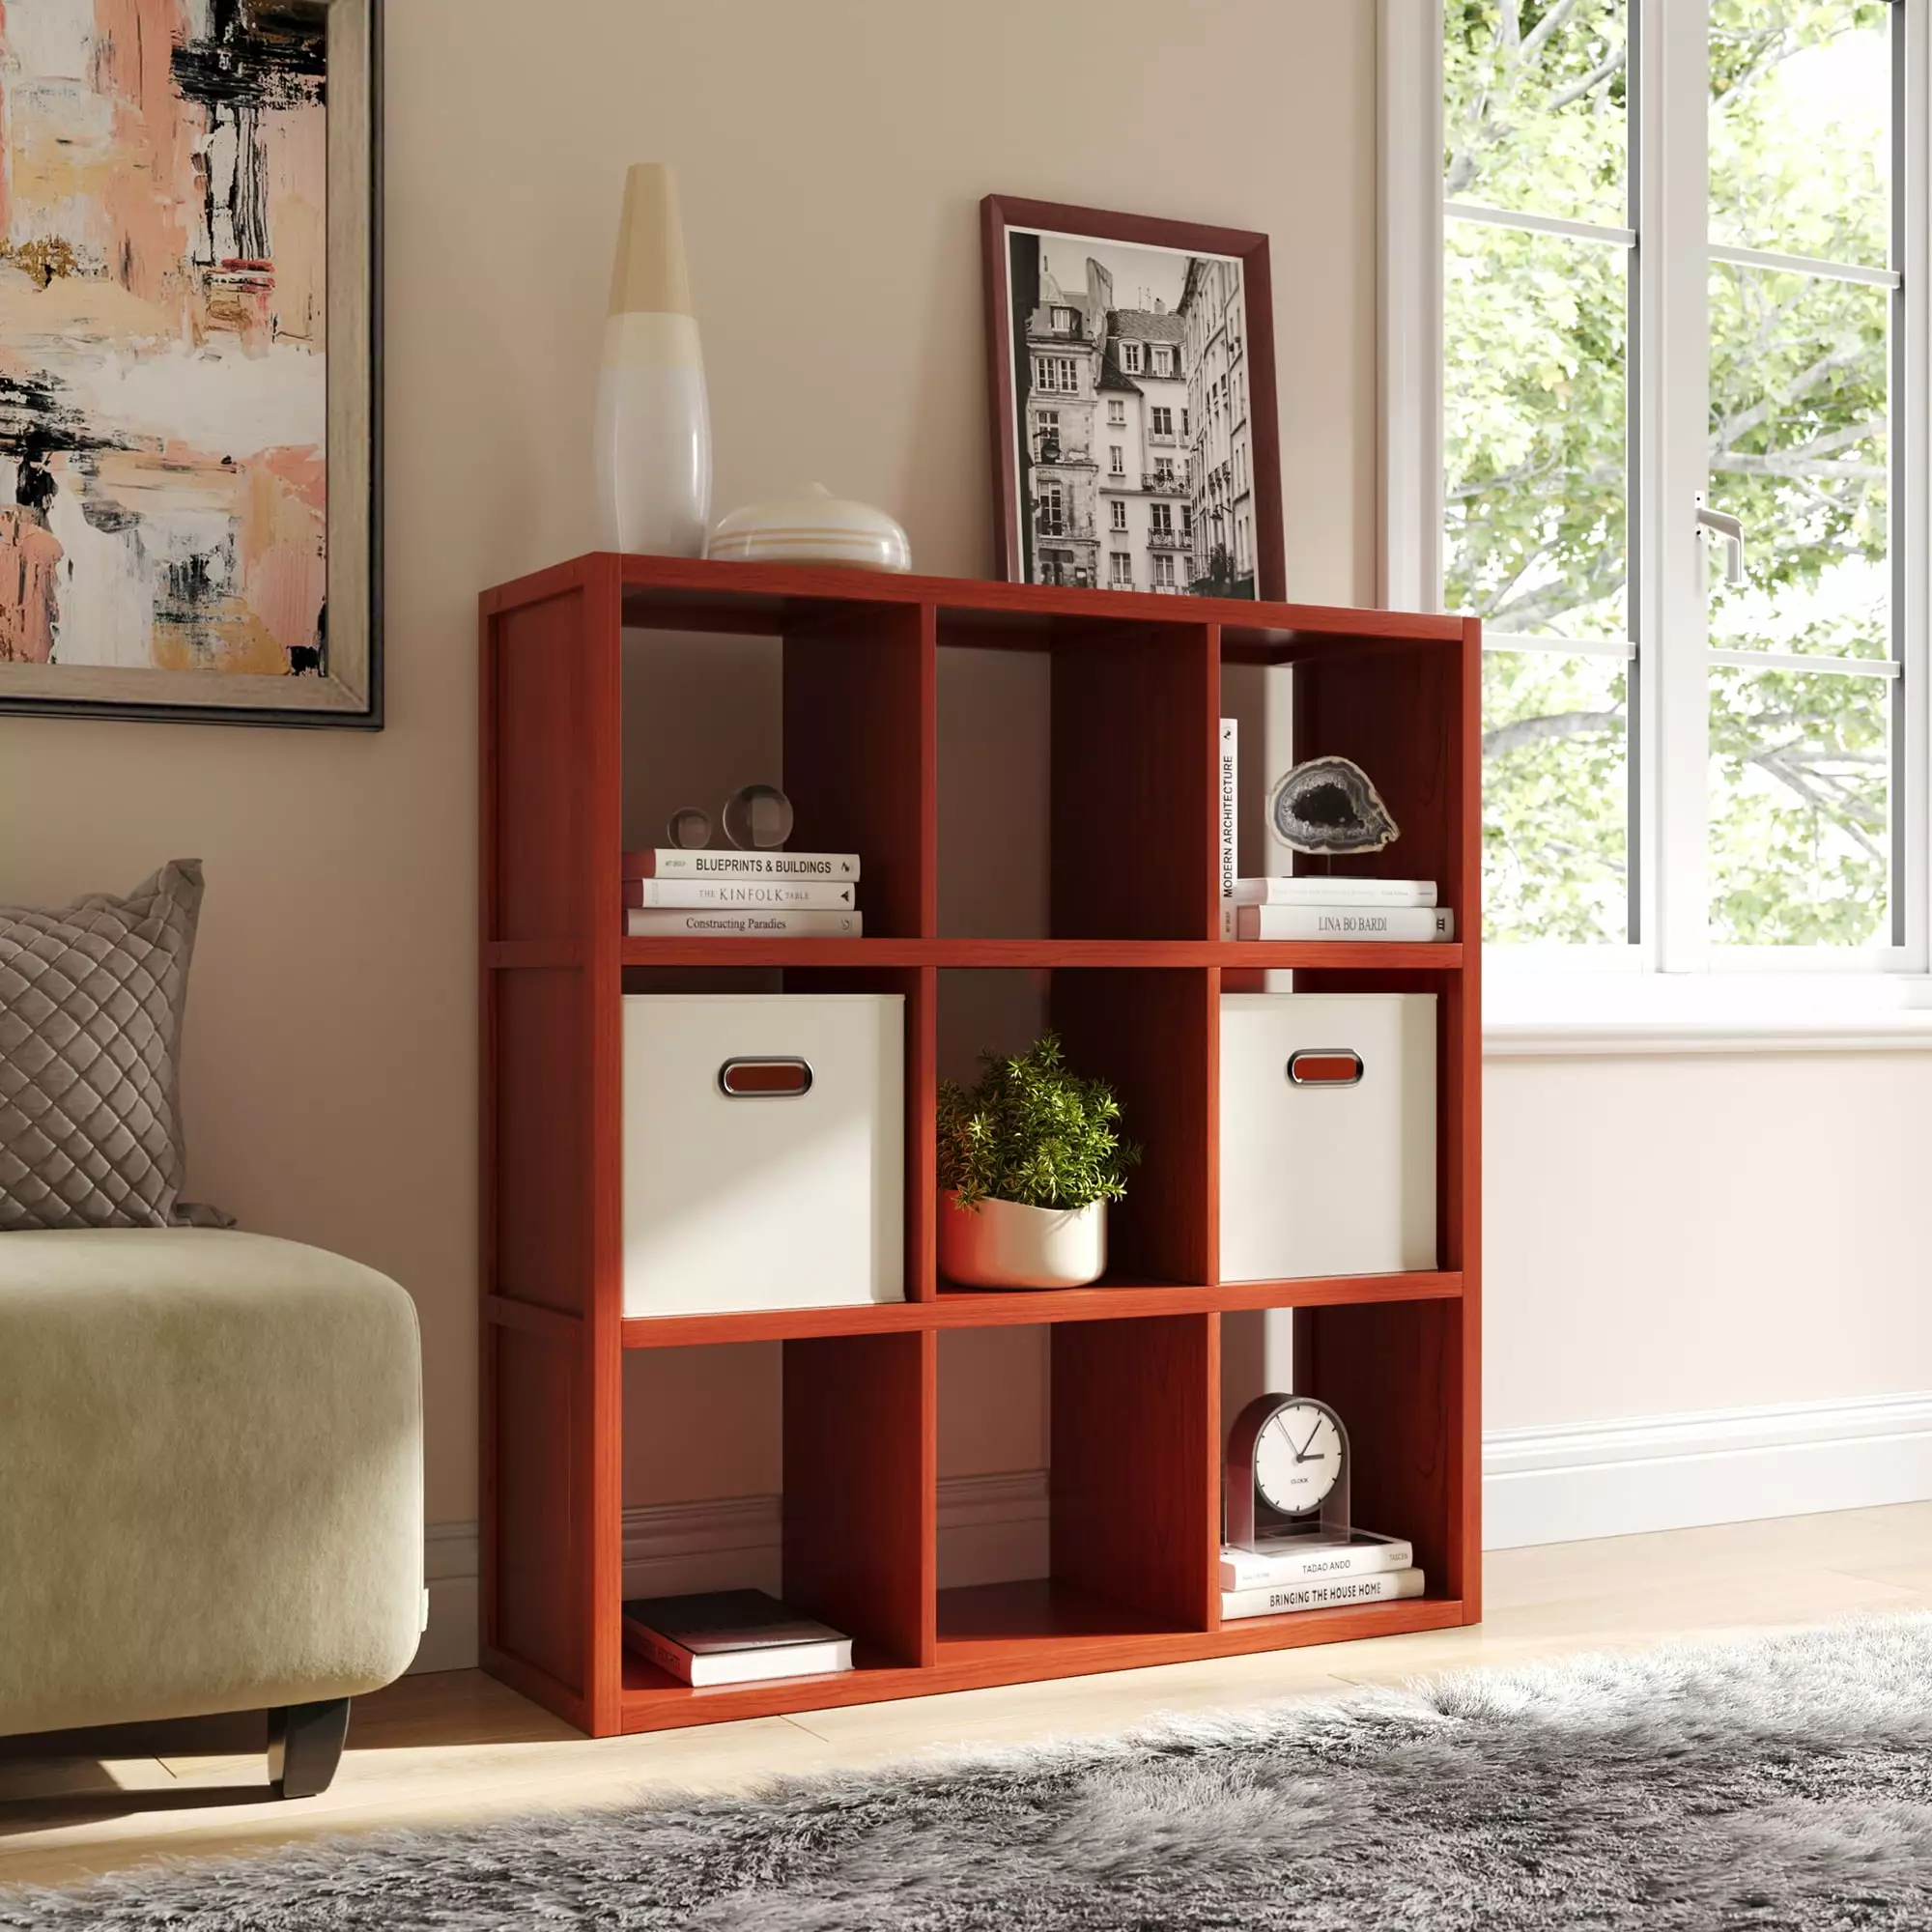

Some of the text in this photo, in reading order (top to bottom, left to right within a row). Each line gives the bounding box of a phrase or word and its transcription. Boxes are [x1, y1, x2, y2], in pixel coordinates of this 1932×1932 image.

[1223, 755, 1233, 897] MODERN ARCHITECTURE
[696, 858, 762, 872] BLUEPRINTS
[765, 859, 774, 871] &
[776, 860, 832, 873] BUILDINGS
[720, 888, 783, 901] KINFOLK
[785, 892, 810, 900] TABLE
[686, 917, 786, 931] Constructing Paradies
[1319, 917, 1387, 931] LINA BO BARDI
[1302, 1559, 1351, 1575] TADAO ANDO
[1269, 1581, 1381, 1607] BRINGING THE HOUSE HOME
